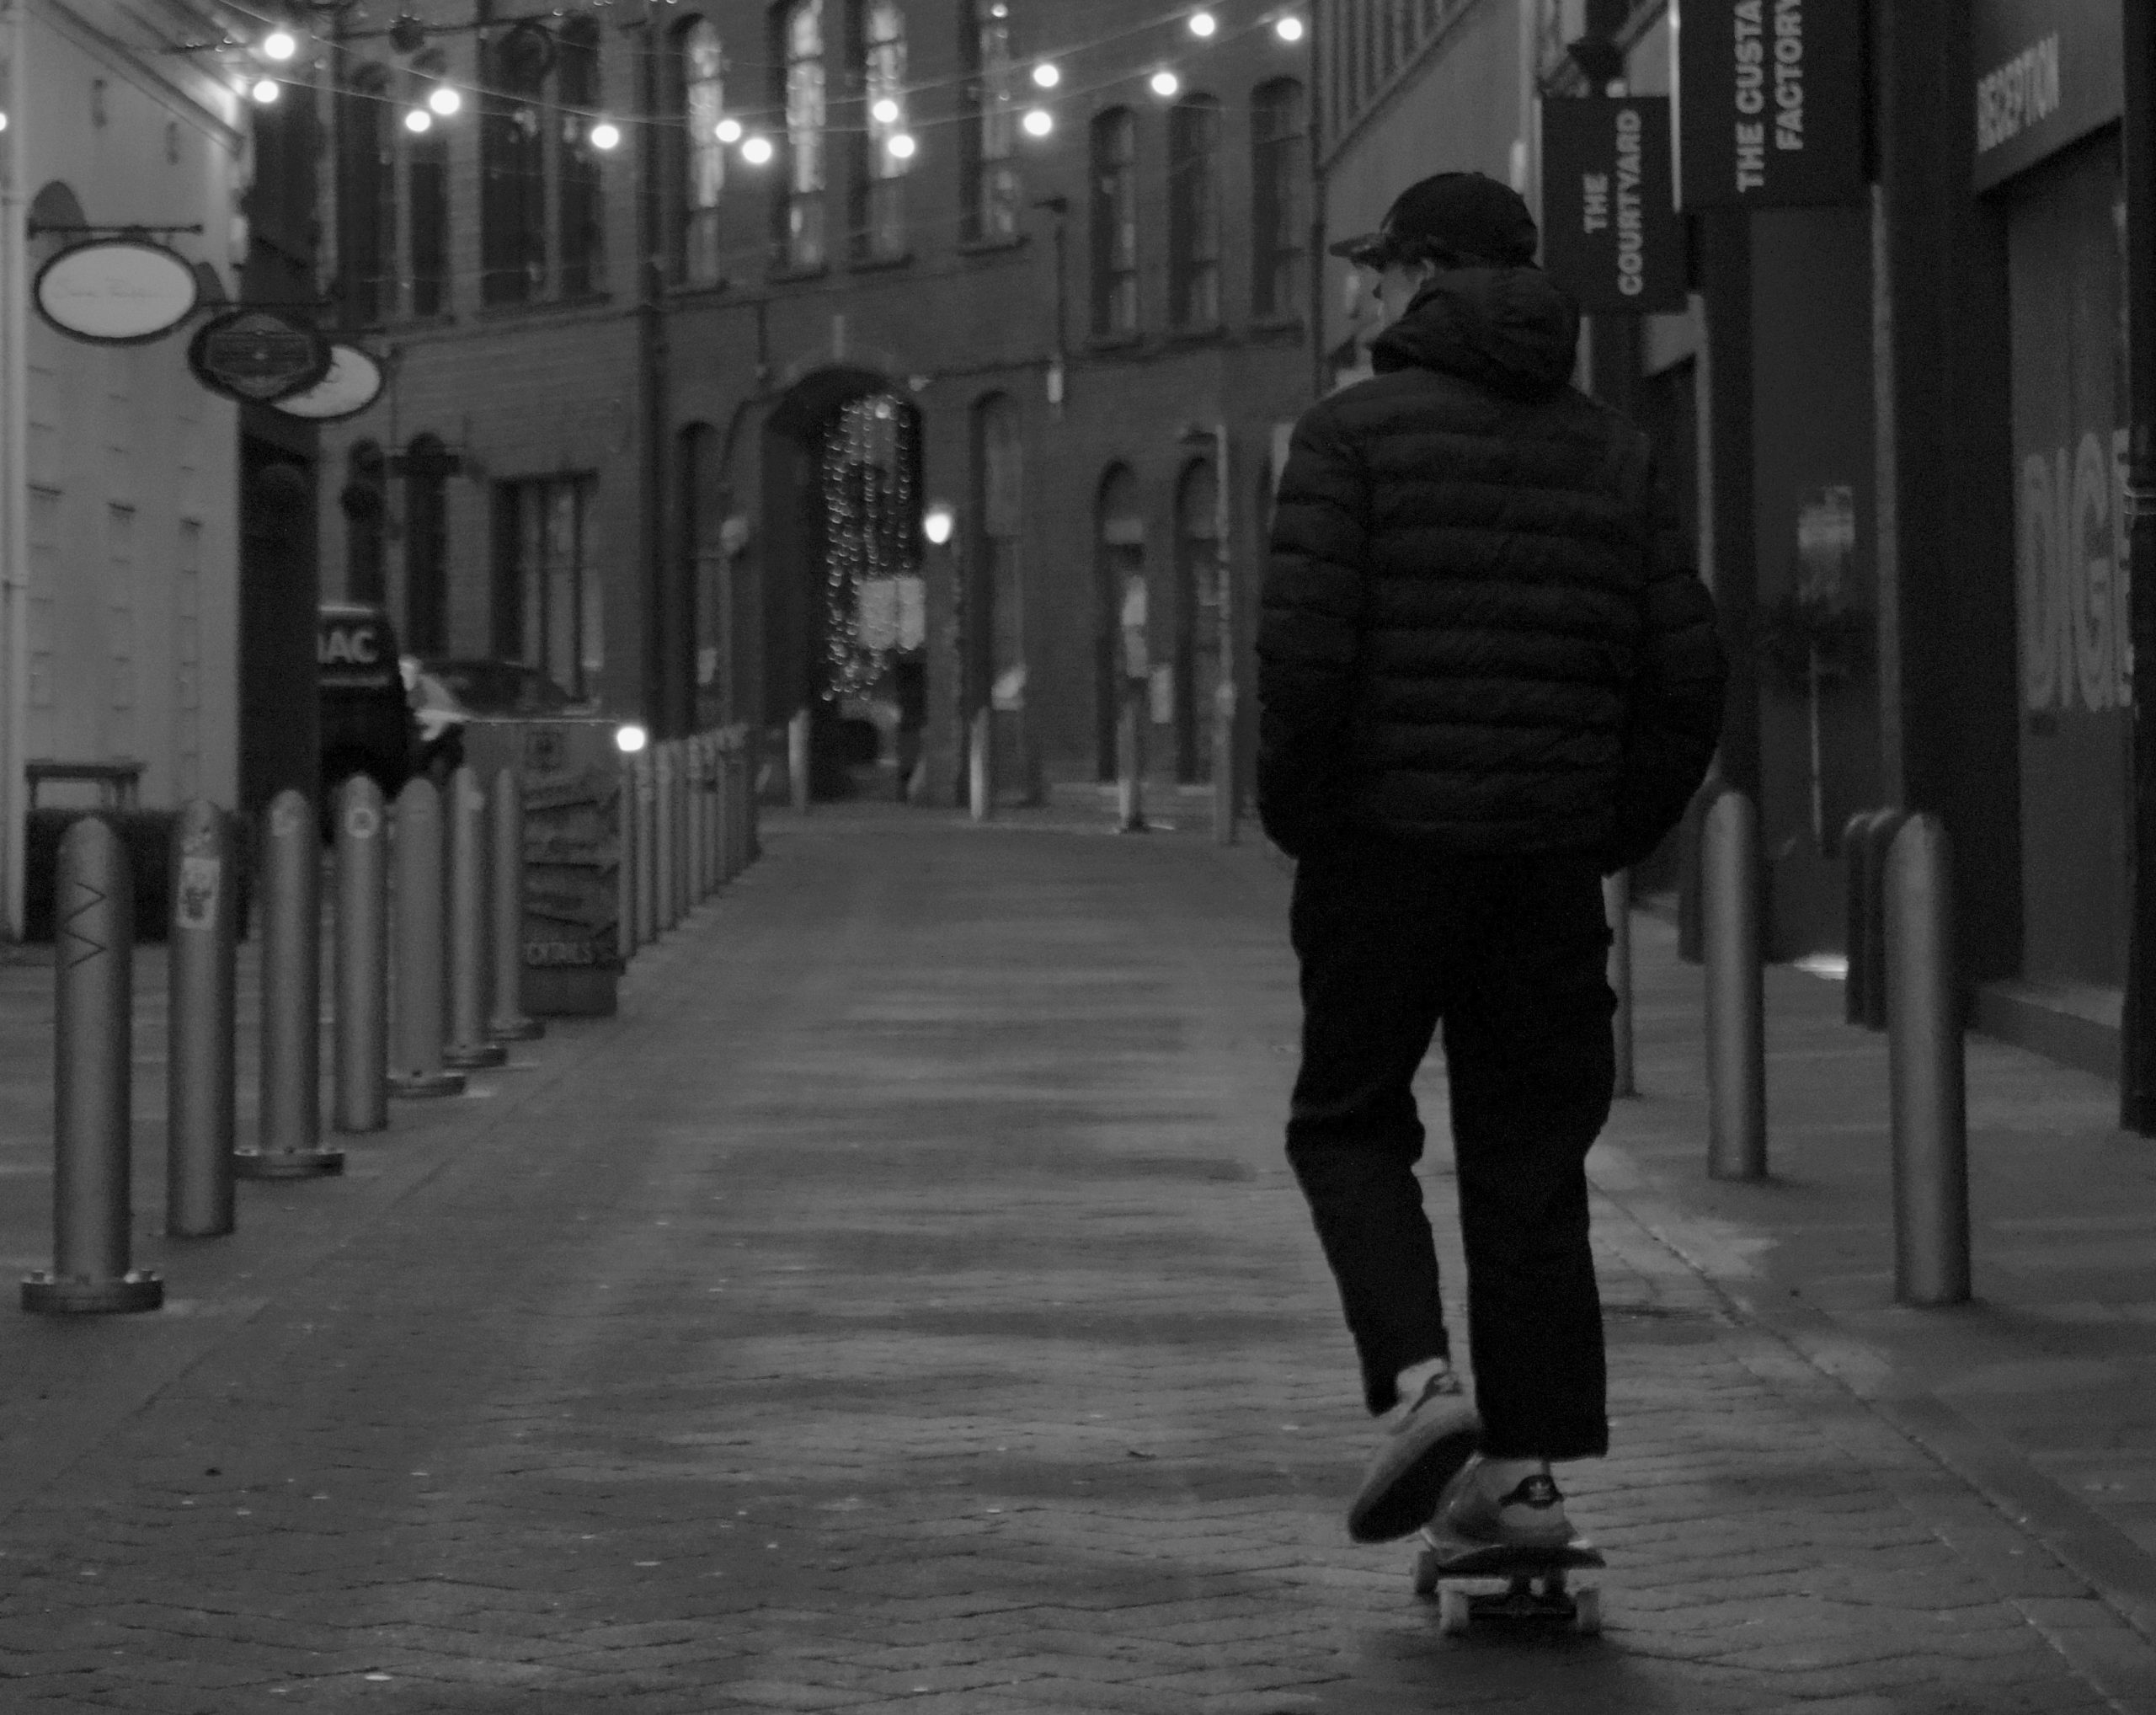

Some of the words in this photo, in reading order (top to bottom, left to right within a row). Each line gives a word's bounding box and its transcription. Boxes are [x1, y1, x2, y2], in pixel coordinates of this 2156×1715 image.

[1734, 0, 1764, 114] CUSTA
[1978, 32, 2058, 153] RECEPTION
[1582, 172, 1609, 233] THE
[1616, 108, 1643, 297] COURTYARD
[1735, 121, 1764, 193] THE
